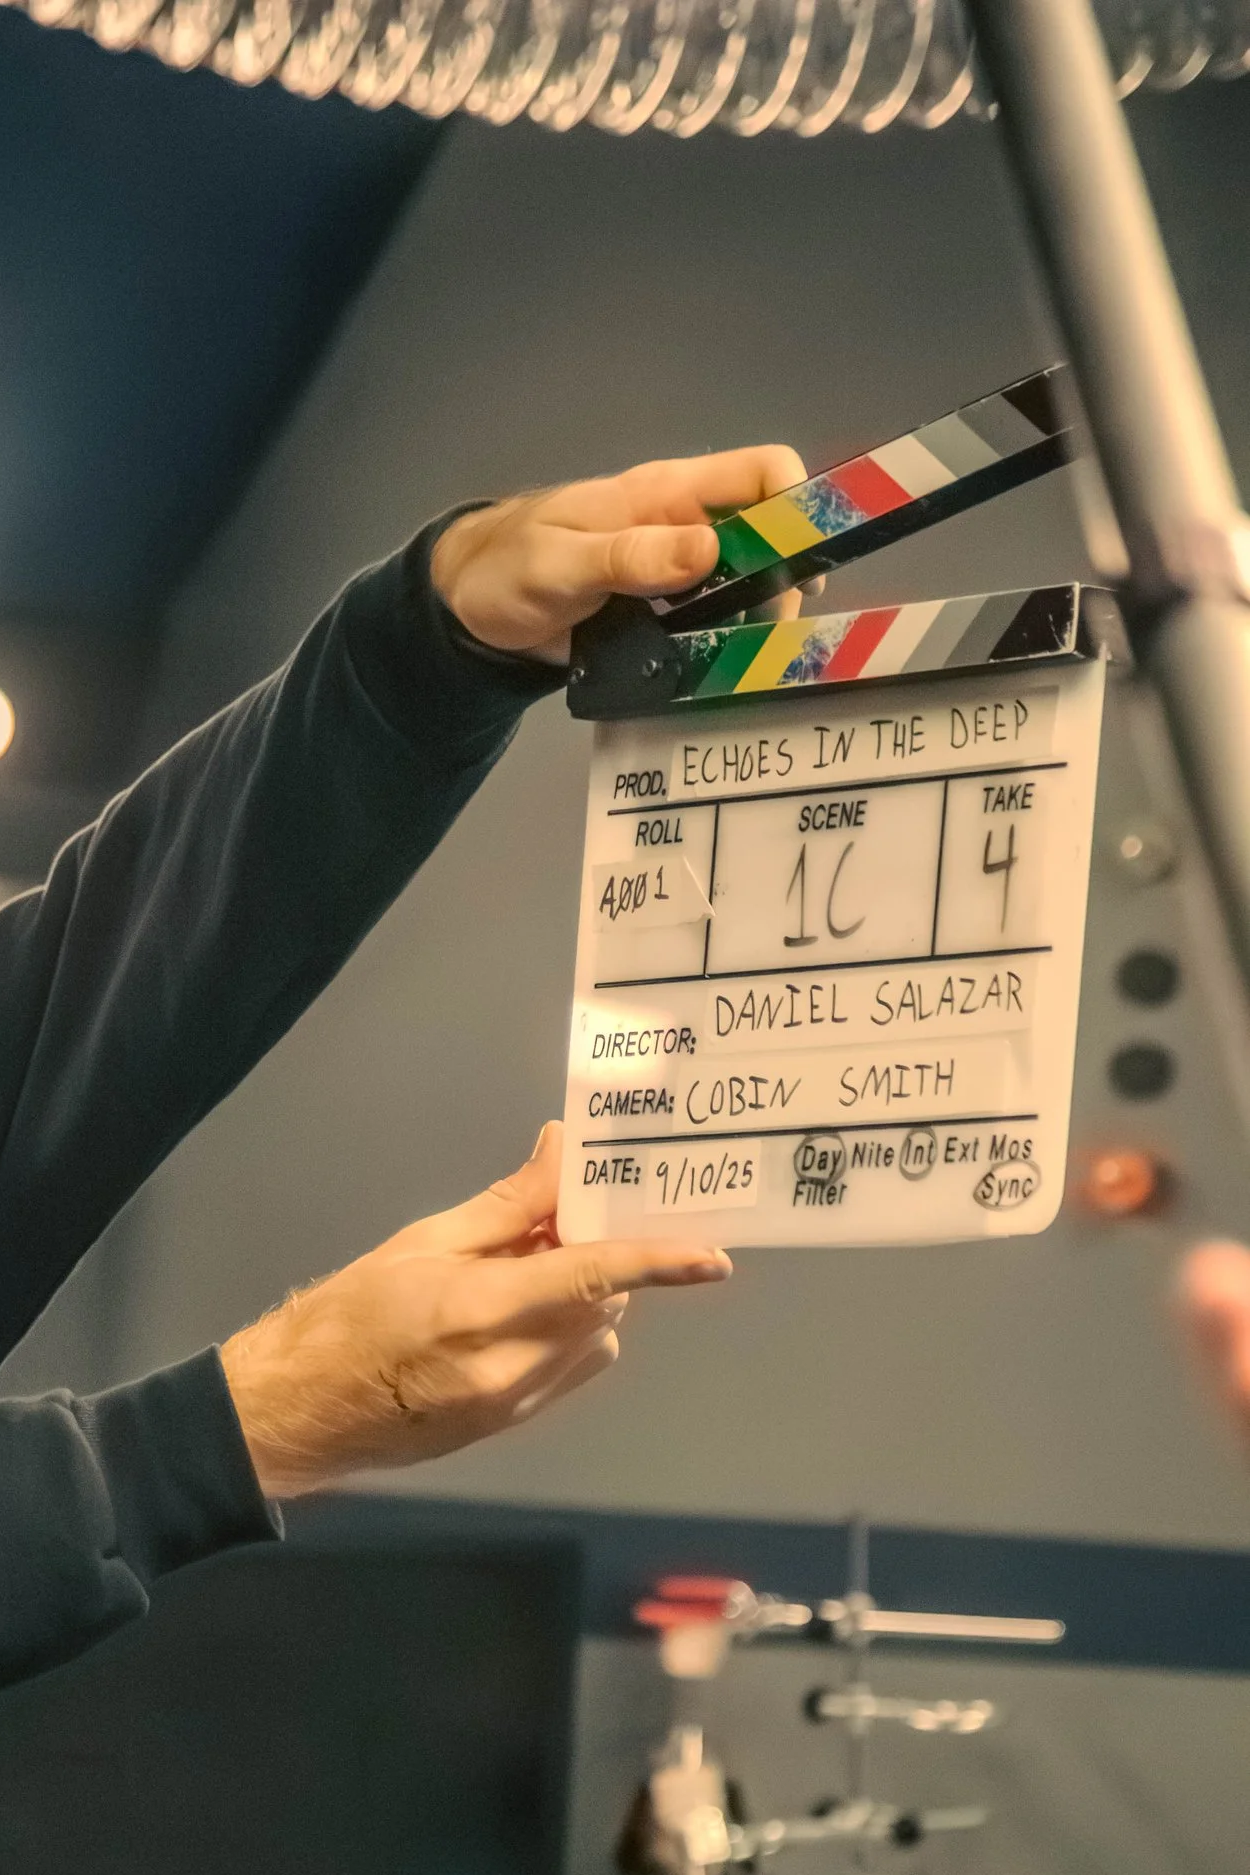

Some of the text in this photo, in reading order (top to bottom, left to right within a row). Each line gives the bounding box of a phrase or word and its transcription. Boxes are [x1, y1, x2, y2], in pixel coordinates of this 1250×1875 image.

[683, 699, 1028, 788] ECHOES IN THE DEEP
[614, 770, 667, 799] PROD.
[982, 782, 1036, 814] TAKE
[635, 817, 684, 847] ROLL
[797, 800, 868, 832] SCENE
[783, 840, 867, 949] 1C
[982, 823, 1018, 934] 4
[714, 970, 1024, 1039] DANIEL SALAZAR
[592, 1027, 697, 1059] DIRECTOR:
[588, 1087, 674, 1119] CAMERA:
[686, 1058, 956, 1125] COBIN SMITH
[583, 1157, 641, 1187] DATE:
[801, 1134, 1032, 1177] Day Nite Int Ext Mos
[655, 1151, 754, 1206] 9/10/25
[792, 1179, 848, 1207] Filter
[981, 1171, 1033, 1207] Sync
